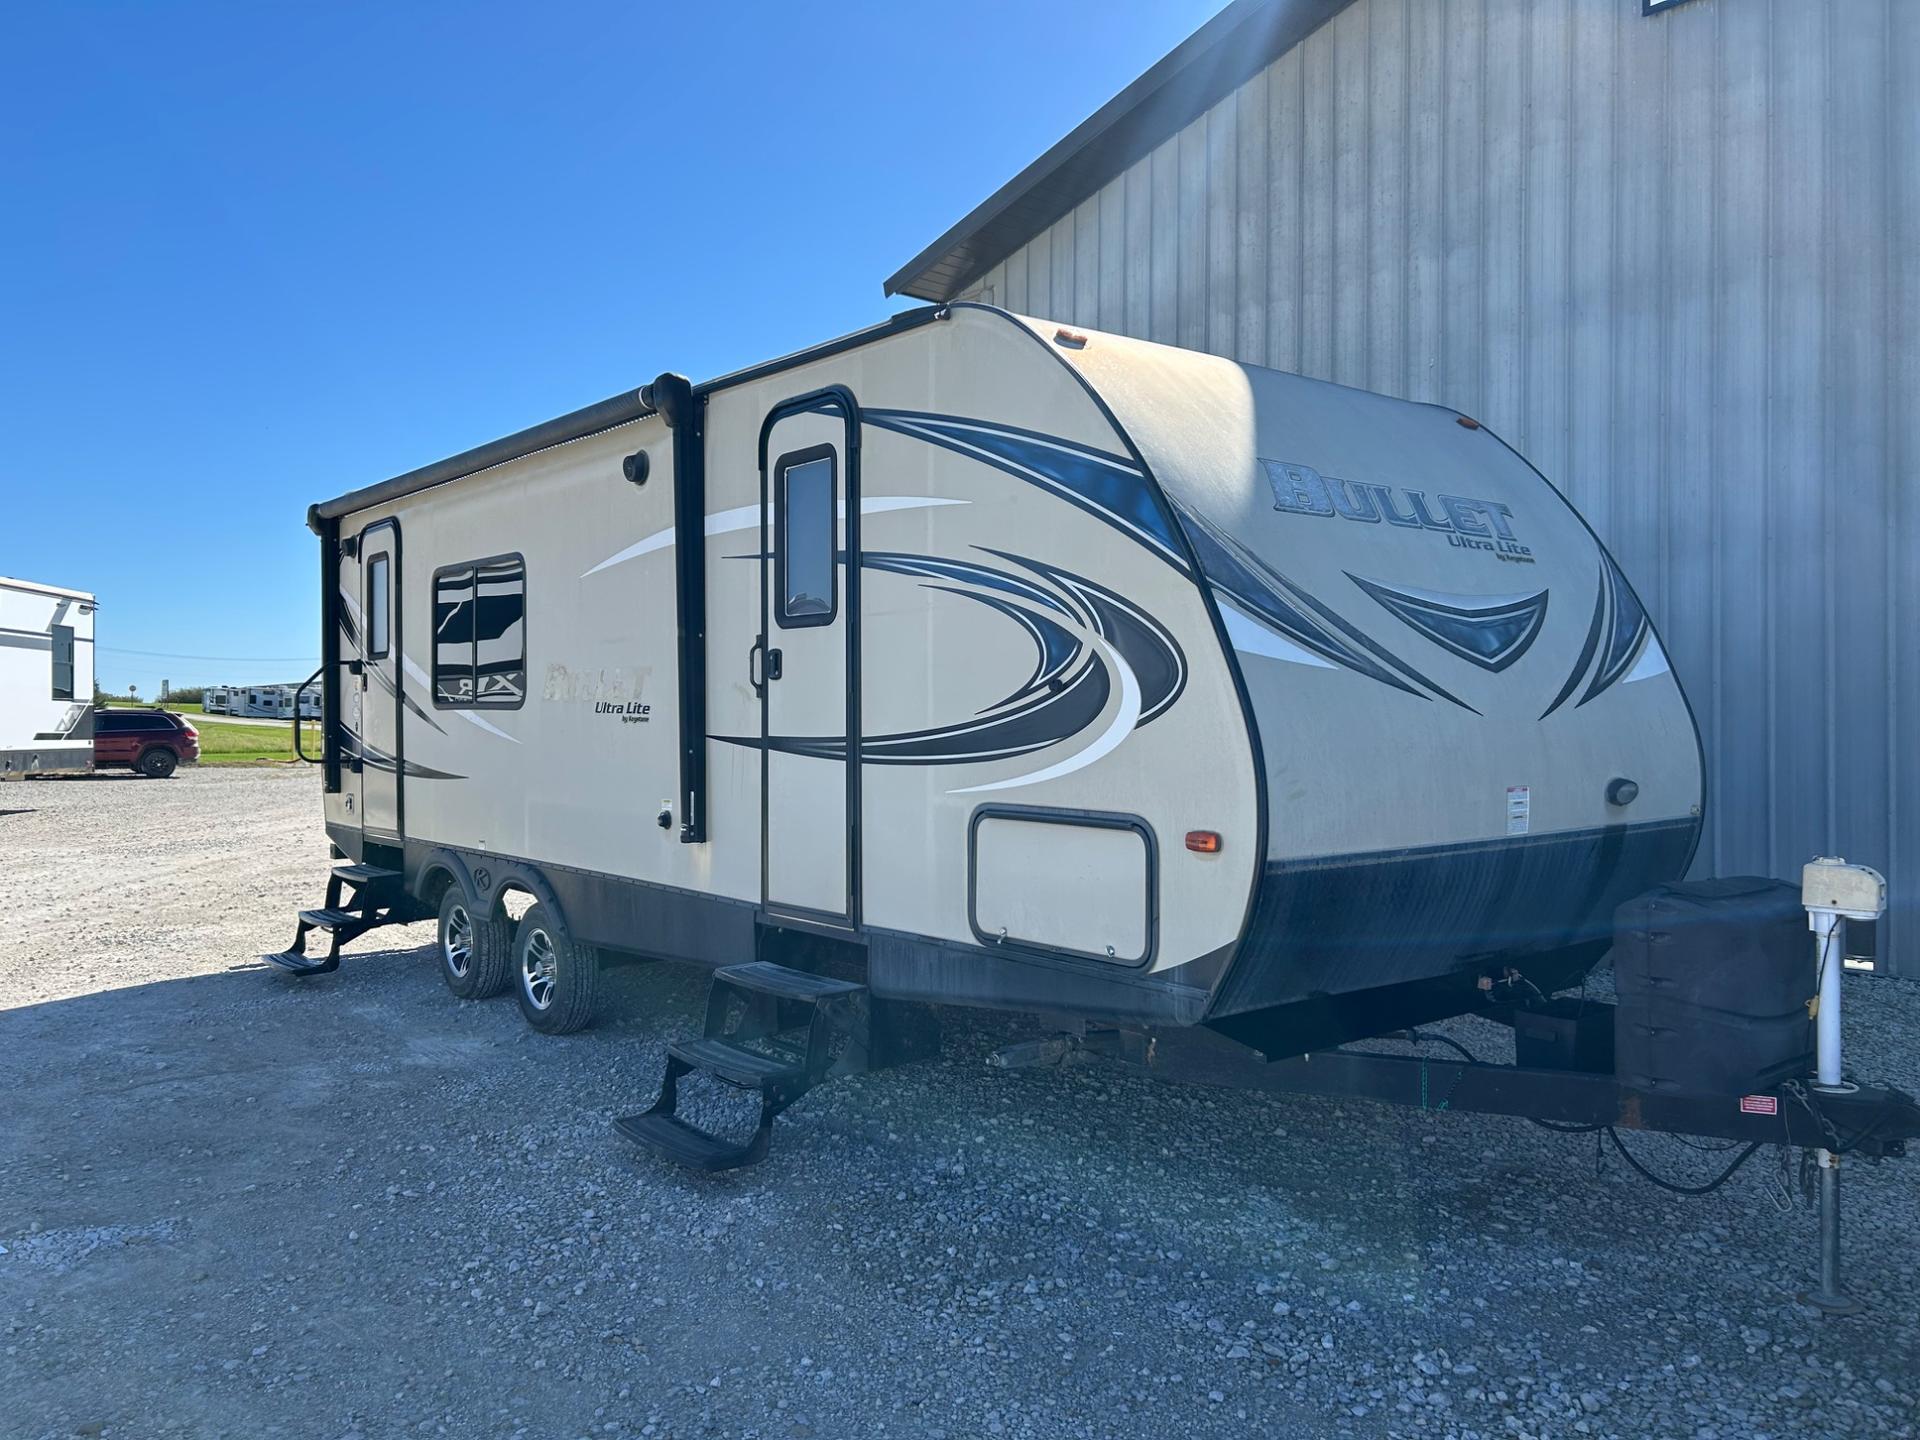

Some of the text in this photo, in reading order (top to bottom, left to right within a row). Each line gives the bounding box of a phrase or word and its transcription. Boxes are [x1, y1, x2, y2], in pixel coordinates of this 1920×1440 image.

[1256, 457, 1517, 541] BULLET
[1446, 534, 1532, 556] Ultra Lite
[595, 701, 651, 715] Ultra Lite
